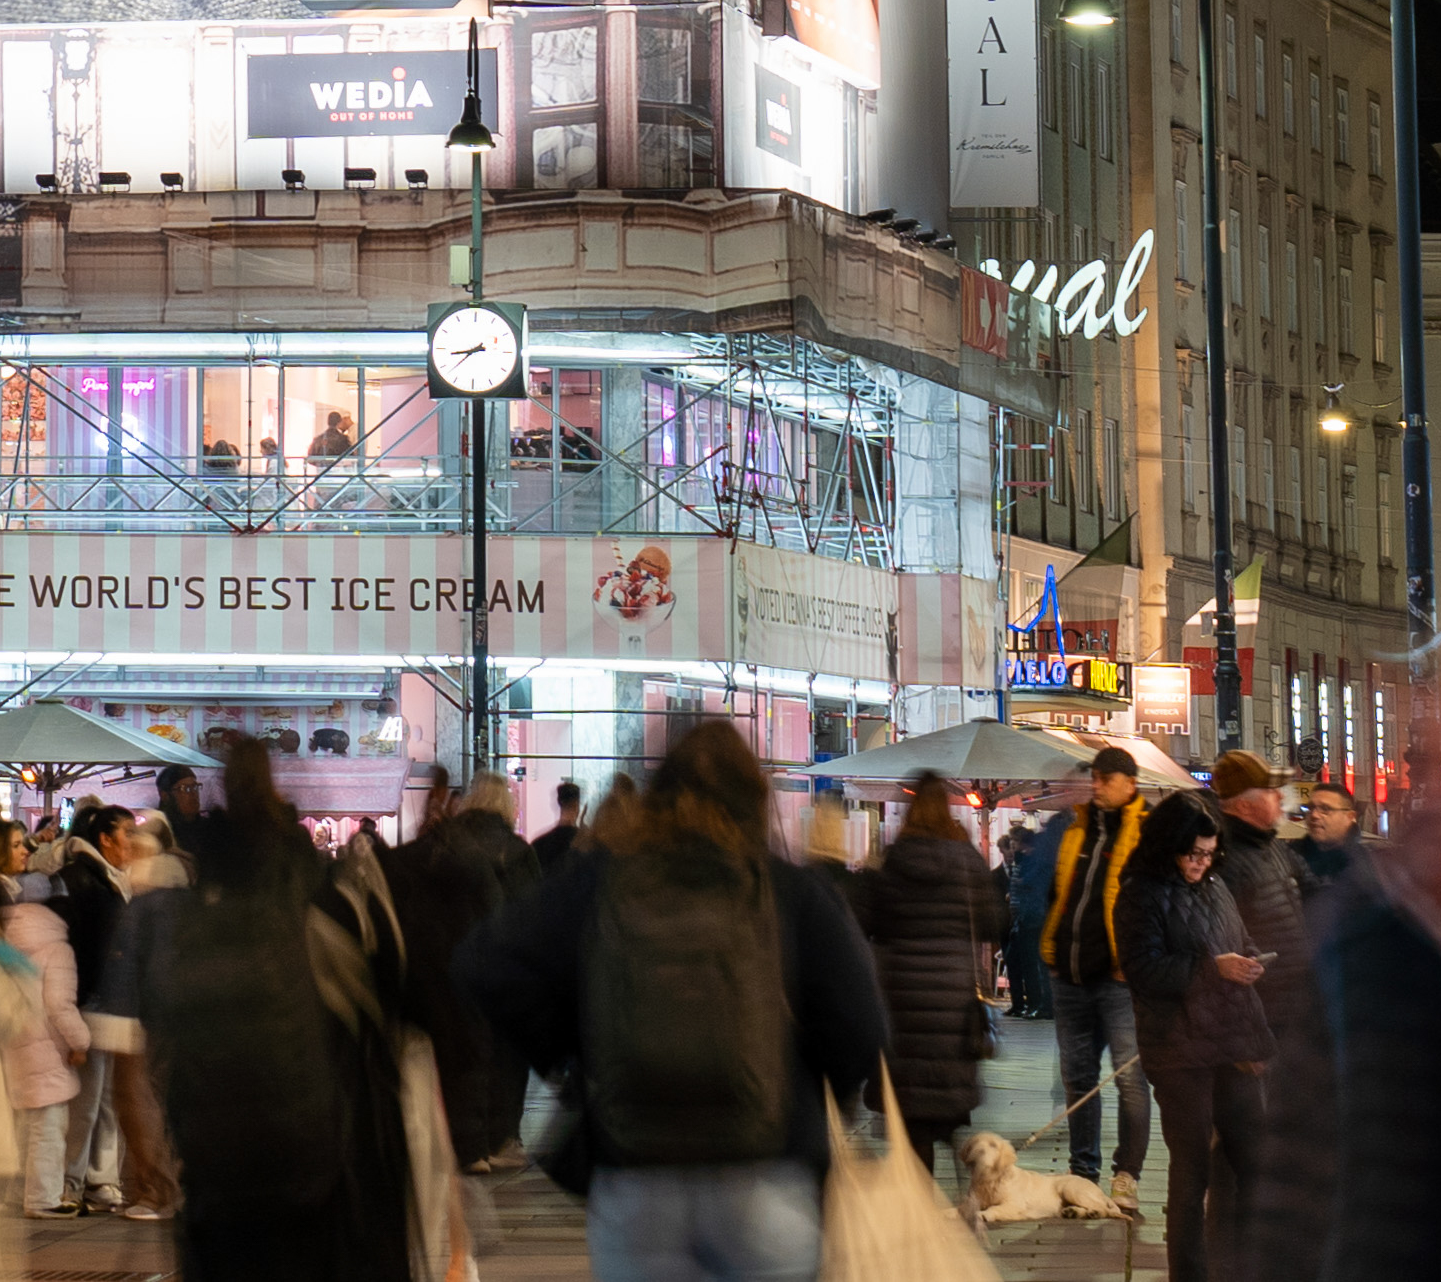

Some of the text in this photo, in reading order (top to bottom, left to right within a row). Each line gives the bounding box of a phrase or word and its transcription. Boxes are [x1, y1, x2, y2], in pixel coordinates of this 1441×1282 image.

[329, 110, 414, 122] OUT OF HOME
[29, 574, 205, 610] WORLD'S
[220, 577, 316, 611] BEST
[331, 578, 395, 611] ICE
[409, 578, 544, 613] CREAM
[1006, 659, 1067, 686] IELO
